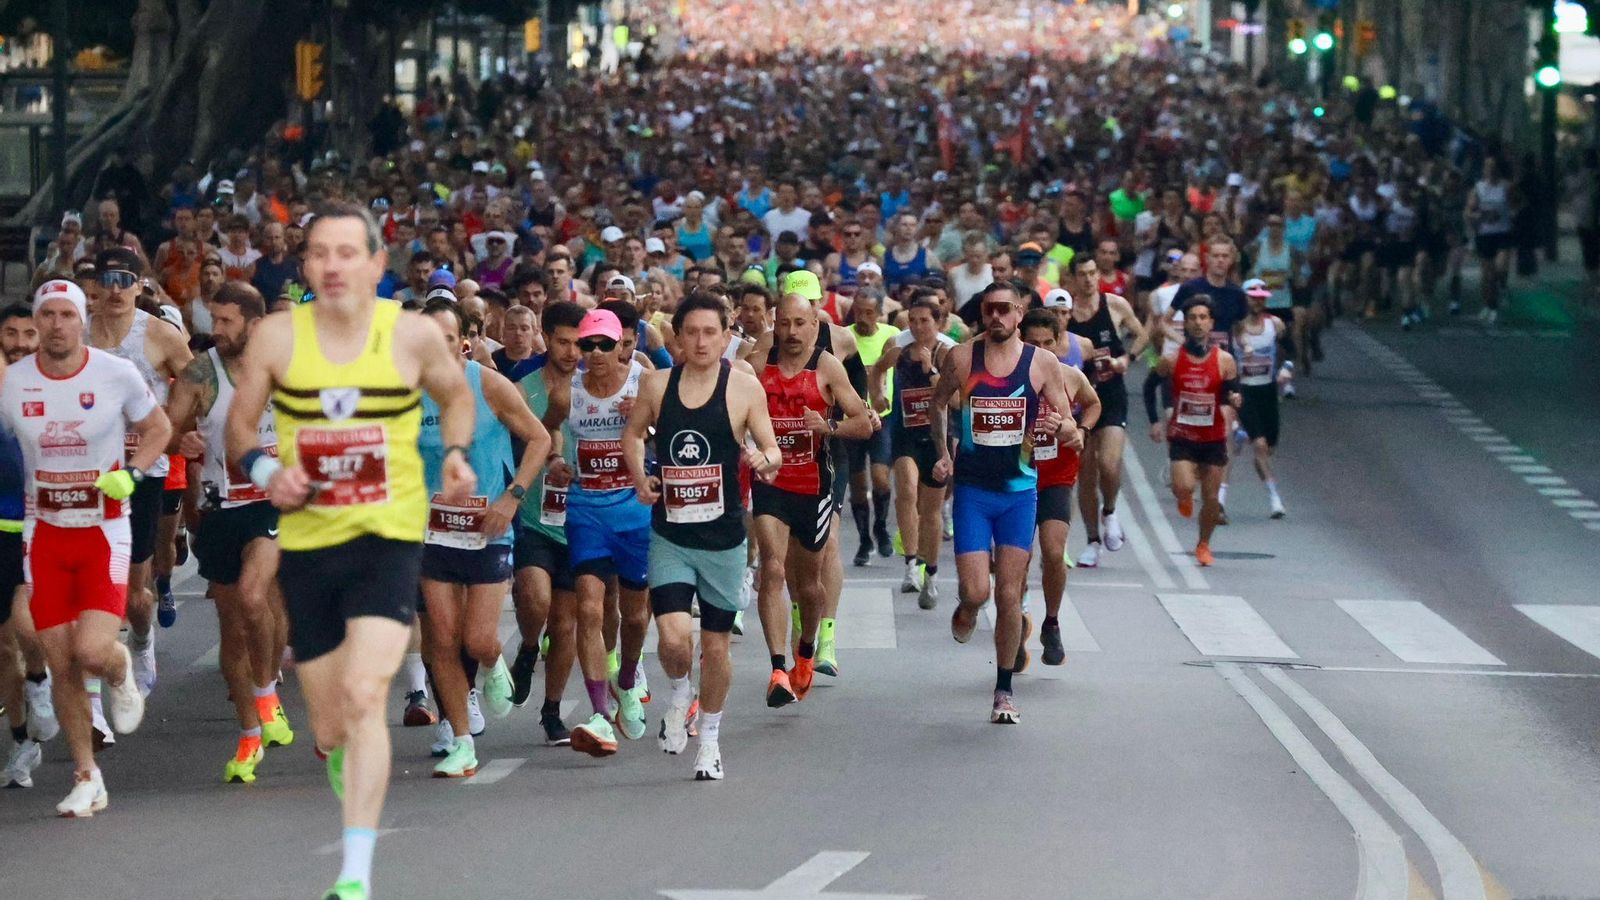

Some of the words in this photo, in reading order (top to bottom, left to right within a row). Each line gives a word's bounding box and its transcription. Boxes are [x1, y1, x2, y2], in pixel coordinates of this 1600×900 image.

[984, 400, 1021, 408] GENERALI
[580, 415, 628, 428] MARACEN
[773, 421, 806, 429] GENERAL
[982, 415, 1014, 425] 13598
[1034, 434, 1048, 442] 44
[589, 441, 621, 450] GENERA
[590, 458, 618, 468] 6168
[675, 468, 717, 478] GENERALI
[46, 490, 88, 502] 15626
[673, 486, 709, 499] 15057
[440, 512, 475, 526] 13862
